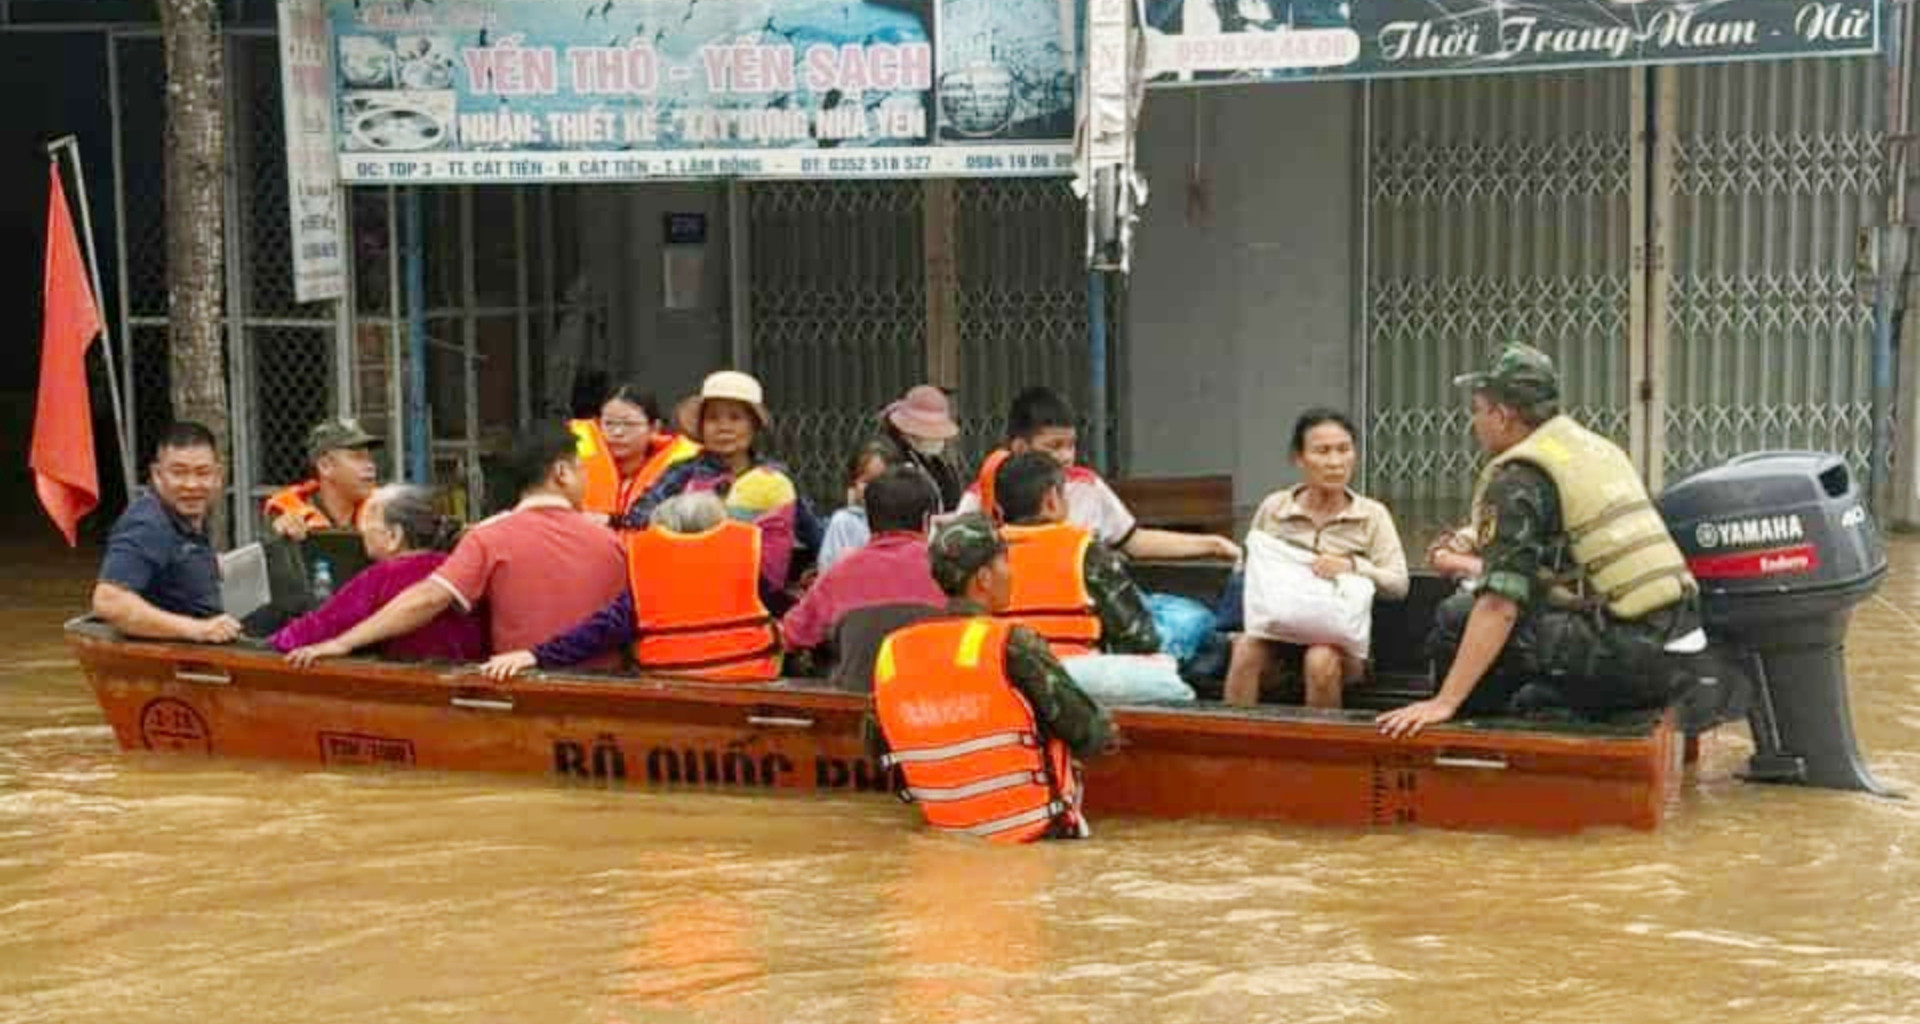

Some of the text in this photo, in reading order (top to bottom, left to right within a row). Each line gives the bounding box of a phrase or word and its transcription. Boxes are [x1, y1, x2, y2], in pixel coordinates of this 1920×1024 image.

[1377, 20, 1480, 62] Thời
[1795, 1, 1870, 42] Nữ
[464, 34, 555, 95] YẾN
[904, 156, 931, 169] 527
[1718, 514, 1803, 545] YAMAHA
